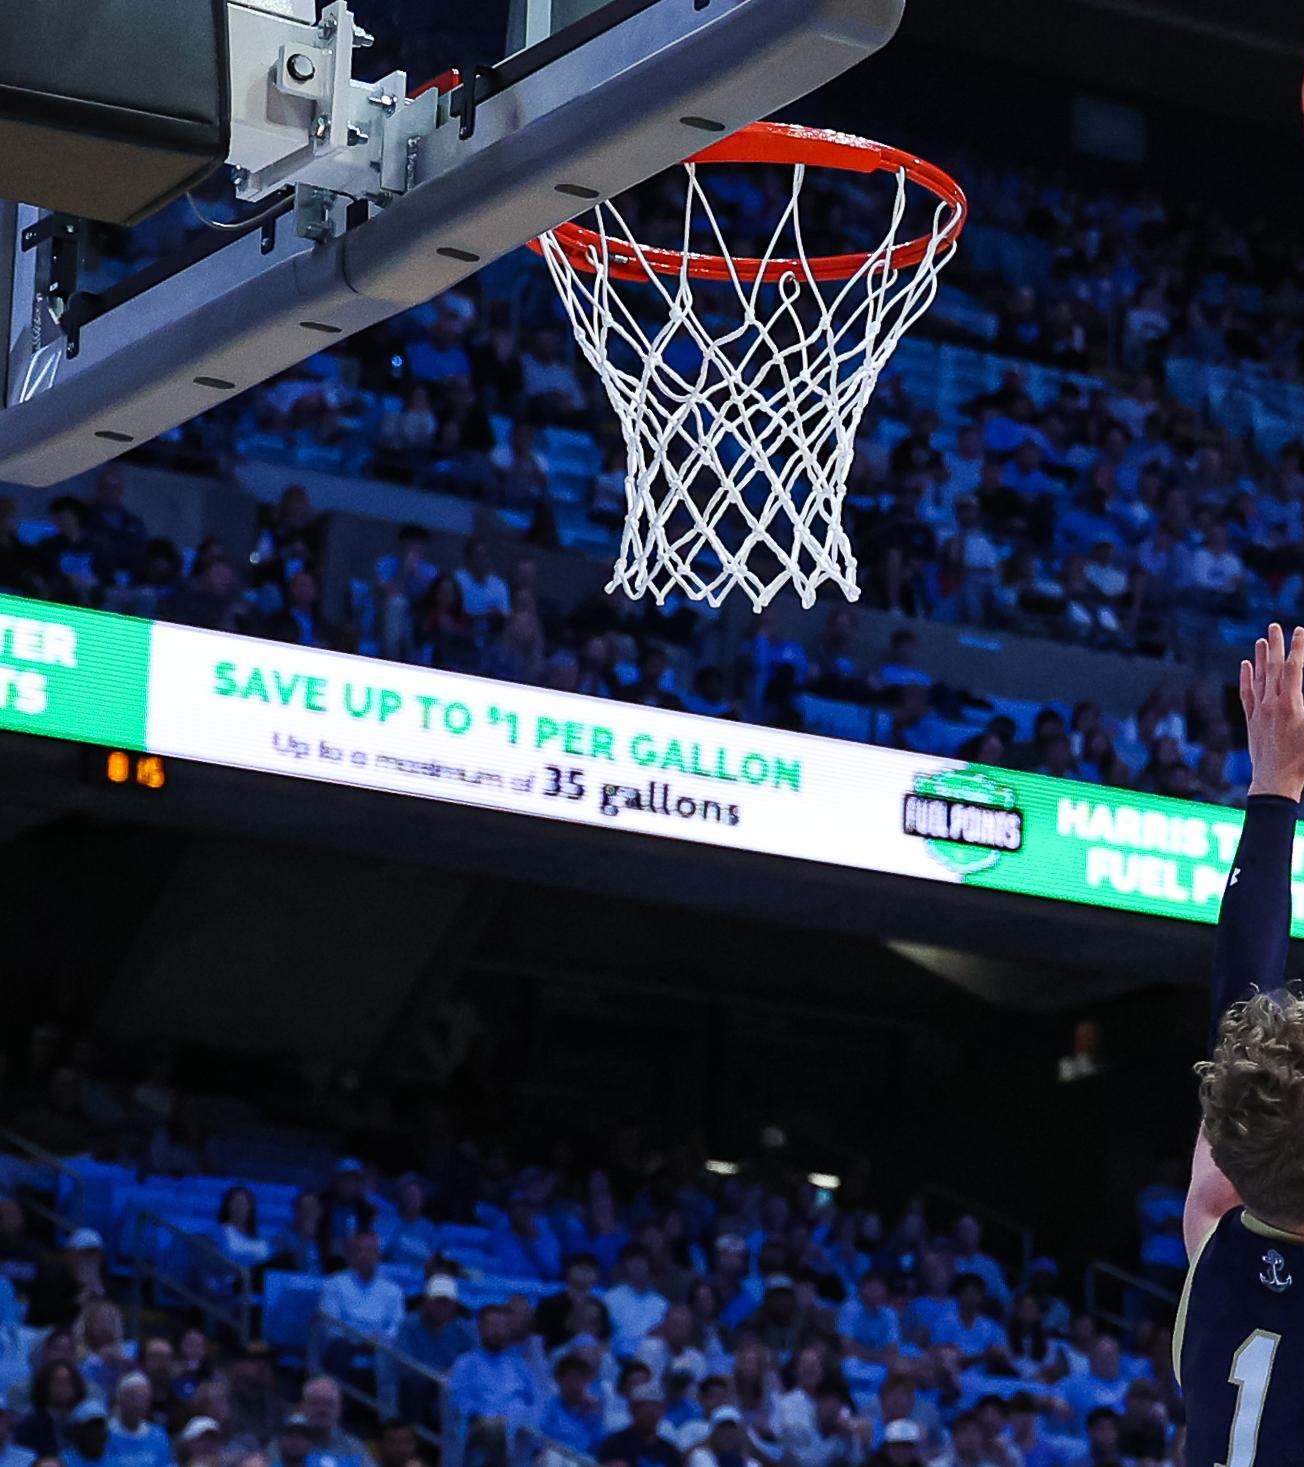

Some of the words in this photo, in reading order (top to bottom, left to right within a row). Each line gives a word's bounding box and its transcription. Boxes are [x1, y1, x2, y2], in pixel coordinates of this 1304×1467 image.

[213, 660, 328, 712] SAVE
[343, 682, 402, 722] UP
[414, 694, 473, 736] TO
[534, 716, 616, 761] PER
[628, 732, 804, 792] GALLON
[543, 762, 585, 800] 35
[600, 779, 740, 827] gallons
[1056, 795, 1210, 860] HARRIS
[1085, 846, 1189, 902] FUEL
[1213, 1327, 1282, 1467] 1
